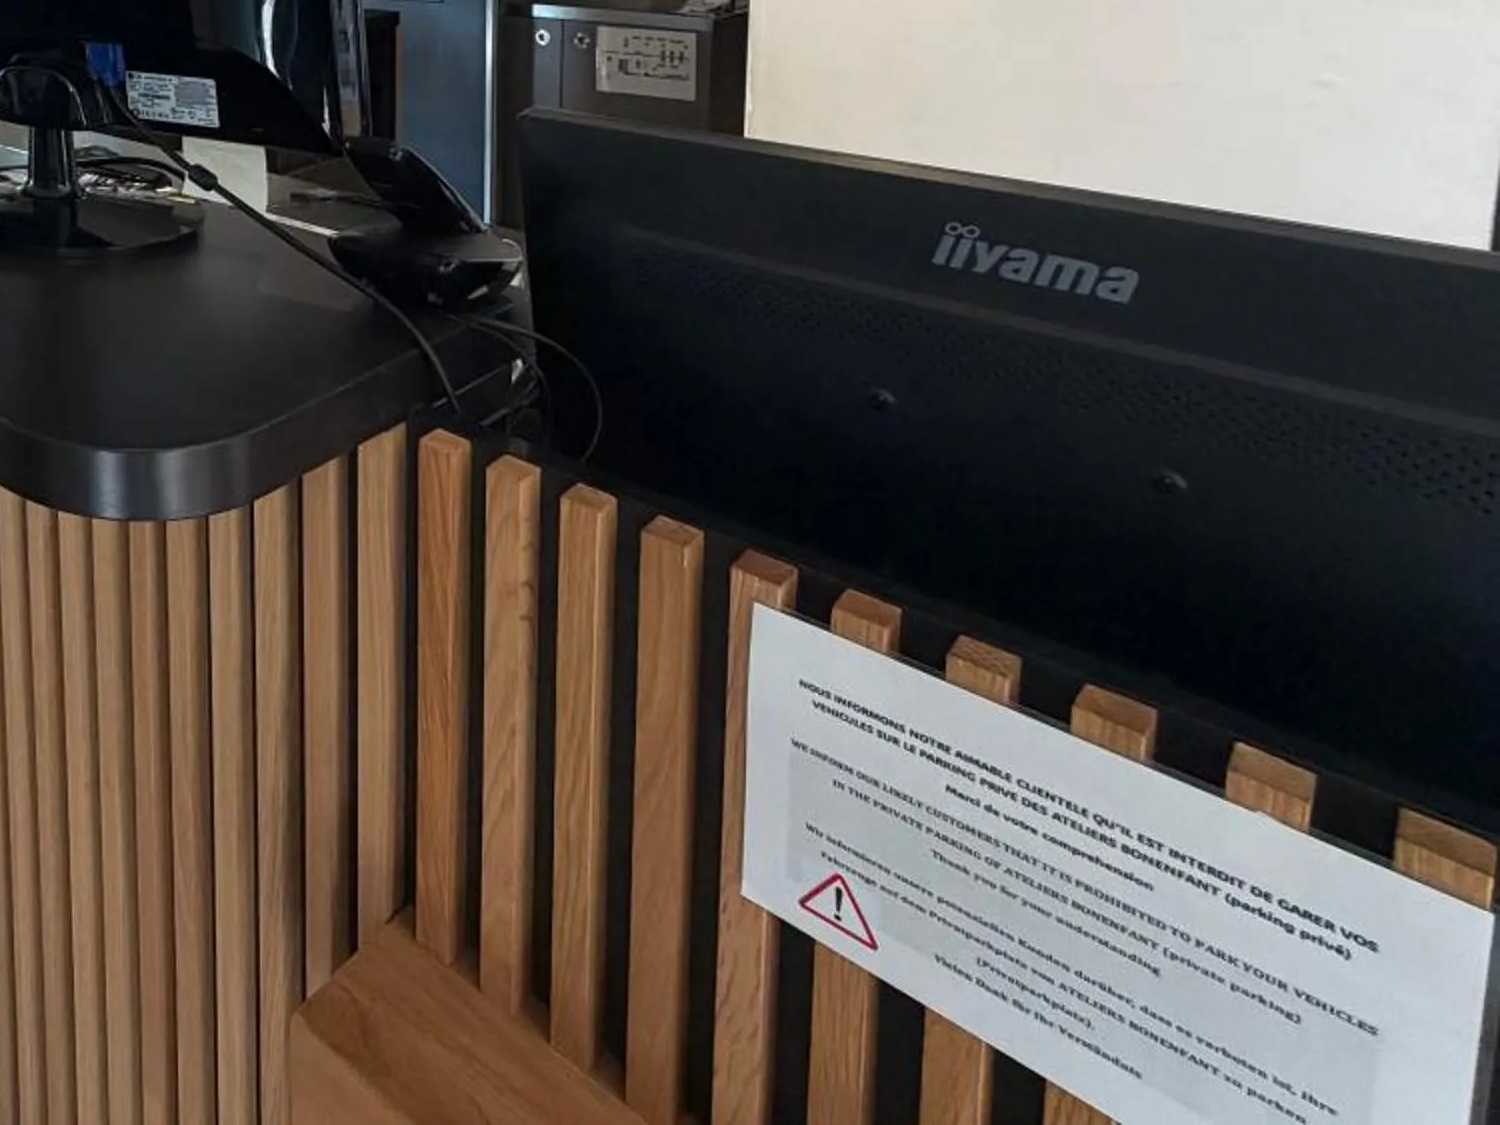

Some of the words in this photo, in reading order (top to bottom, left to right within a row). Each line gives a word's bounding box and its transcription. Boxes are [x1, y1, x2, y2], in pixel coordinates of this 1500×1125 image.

[932, 222, 1140, 305] iiyama
[799, 678, 832, 699] NOUS
[833, 695, 906, 734] INFORMONS
[909, 725, 953, 756] NOTRE
[955, 747, 1013, 783] AIMABLE
[1016, 778, 1089, 819] CLIENTELE
[1093, 812, 1133, 839] QU'IL
[1137, 832, 1164, 856] EST
[1168, 848, 1248, 890] INTERDIT
[1250, 885, 1274, 904] DE
[1278, 898, 1336, 934] GARER
[1341, 927, 1380, 953] VOS
[812, 700, 875, 734] VEHICULES
[876, 729, 902, 747] SUR
[903, 740, 917, 755] LE
[919, 747, 976, 782] PARKING
[979, 776, 1018, 803] PRIVE
[1020, 796, 1048, 817] DES
[1051, 806, 1117, 850] ATELIERS
[1121, 842, 1221, 898] BONENFANT
[1224, 892, 1296, 936] (parking
[1299, 928, 1352, 960] privé)
[931, 849, 971, 876] Thank
[945, 784, 982, 808] Merci
[983, 802, 1001, 818] de
[1002, 810, 1039, 836] votre
[848, 786, 871, 804] THE
[872, 799, 924, 832] PRIVATE
[925, 825, 982, 861] PARKING
[983, 854, 1002, 870] OF
[1003, 866, 1069, 905] ATELIERS
[1071, 897, 1161, 952] BONENFANT
[1163, 946, 1226, 985] (private
[1229, 981, 1303, 1025] parking)
[925, 804, 1002, 848] CUSTOMERS
[1001, 842, 1042, 869] THAT
[1075, 878, 1172, 931] PROHIBITED
[1169, 922, 1192, 943] TO
[1195, 938, 1238, 966] PARK
[1238, 961, 1289, 993] YOUR
[1293, 986, 1380, 1037] VEHICLES
[1057, 981, 1126, 1024] ATELIERS
